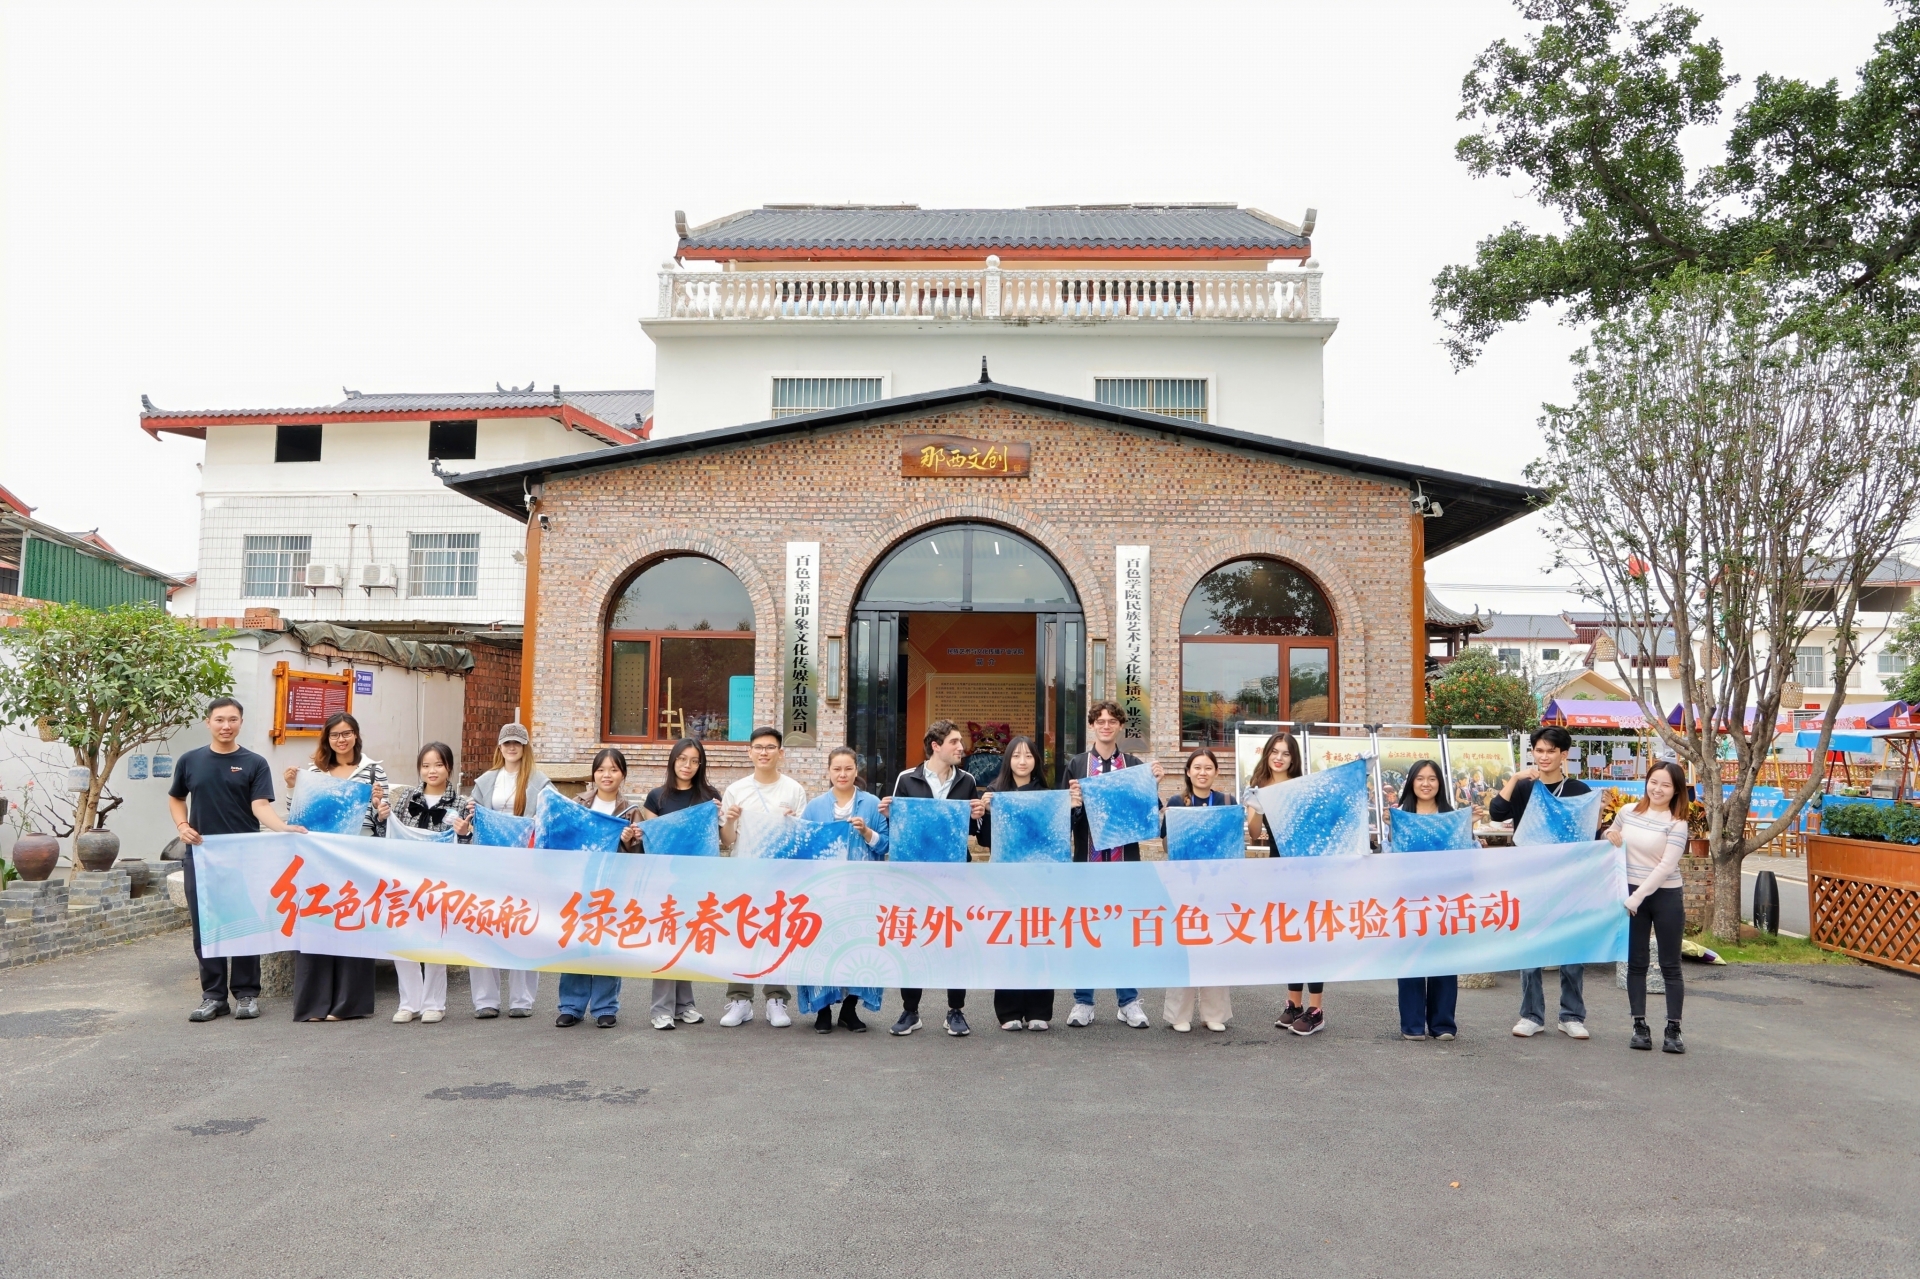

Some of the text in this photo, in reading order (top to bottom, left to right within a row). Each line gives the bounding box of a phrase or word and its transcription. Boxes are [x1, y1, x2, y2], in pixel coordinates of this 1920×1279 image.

[920, 445, 1008, 473] 那西文创
[792, 554, 811, 734] 百色幸福印象文化传媒有限公司
[1124, 557, 1142, 739] 百色学院民族艺术与文化传播产业学院
[269, 854, 1521, 979] 红色信仰领航 绿色青春飞扬 海外“Z世代”百色文化体验行活动
